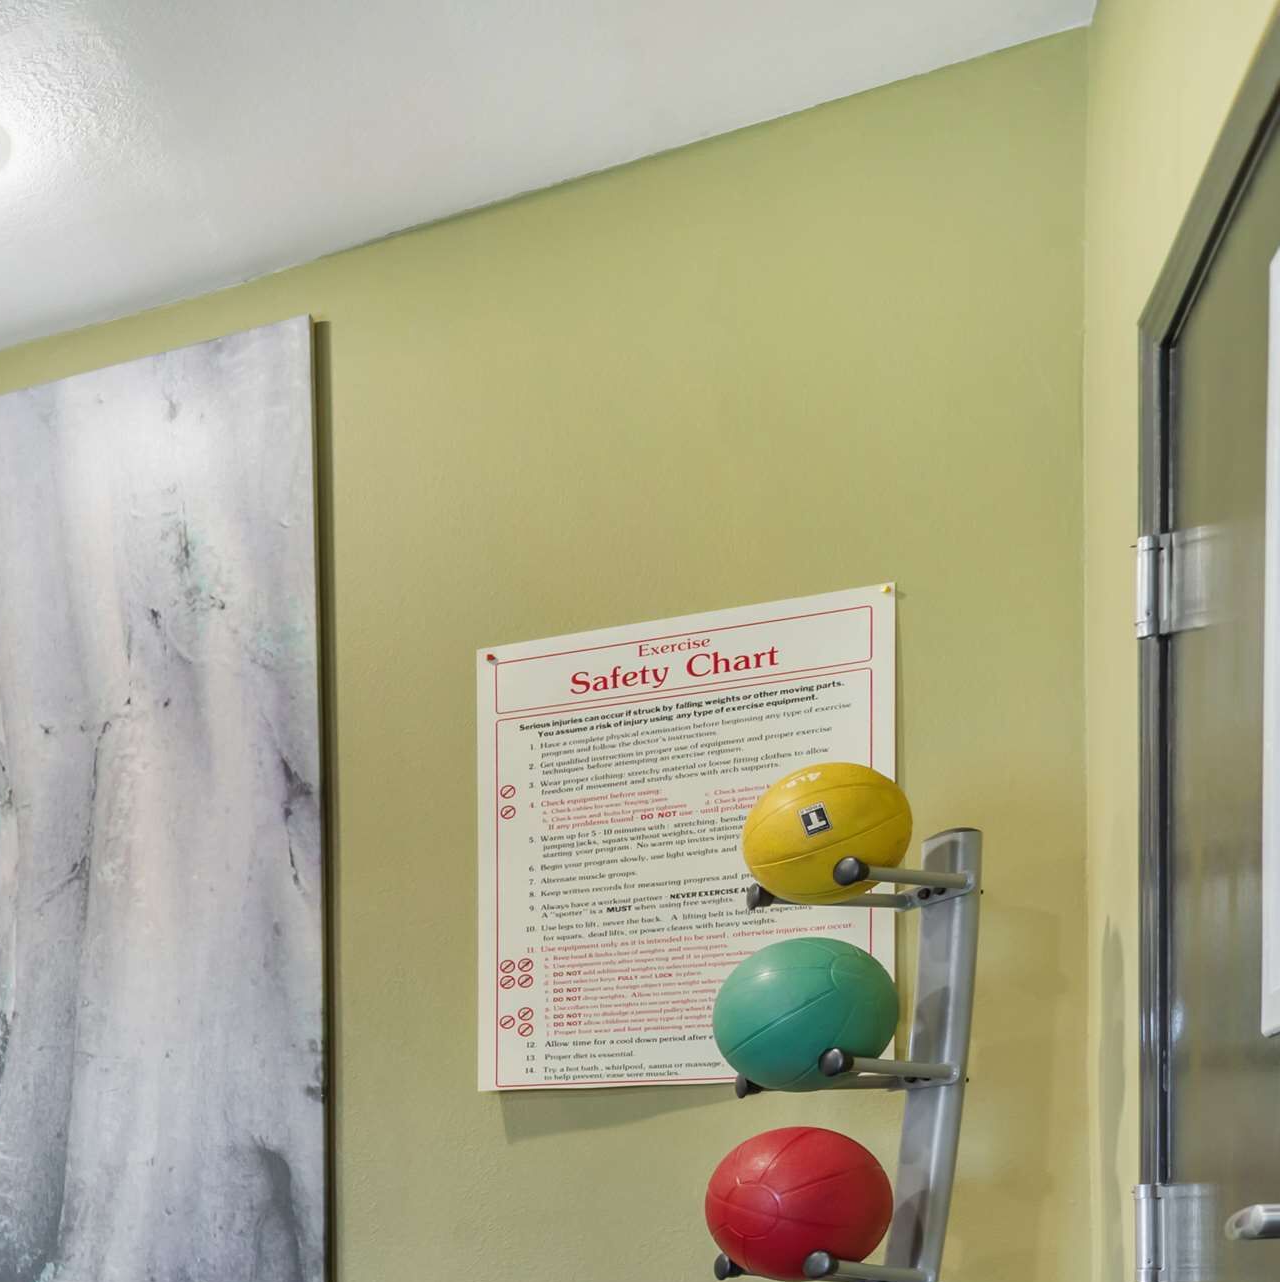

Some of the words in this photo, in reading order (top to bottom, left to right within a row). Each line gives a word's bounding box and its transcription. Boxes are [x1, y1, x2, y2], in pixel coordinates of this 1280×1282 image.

[637, 637, 711, 658] Exercise
[569, 664, 669, 695] Safety
[686, 645, 780, 678] Chart
[518, 721, 550, 731] Serious
[551, 716, 582, 728] injuries
[600, 711, 623, 720] occur
[633, 705, 660, 715] struck
[675, 699, 702, 711] falling
[704, 694, 740, 707] weights
[753, 688, 777, 698] other
[779, 683, 814, 696] moving
[537, 729, 554, 737] You
[555, 726, 587, 735] assume
[595, 721, 611, 730] risk
[623, 716, 648, 727] injury
[649, 713, 673, 724] using
[676, 711, 691, 720] any
[693, 707, 713, 718] type
[725, 700, 764, 712] exercise
[657, 810, 676, 818] NOT
[540, 874, 576, 884] Alternate
[578, 872, 606, 880] muscle
[669, 891, 697, 899] NEVER
[698, 887, 738, 897] EXERCISE
[606, 904, 631, 913] MUST
[658, 1035, 685, 1044] period
